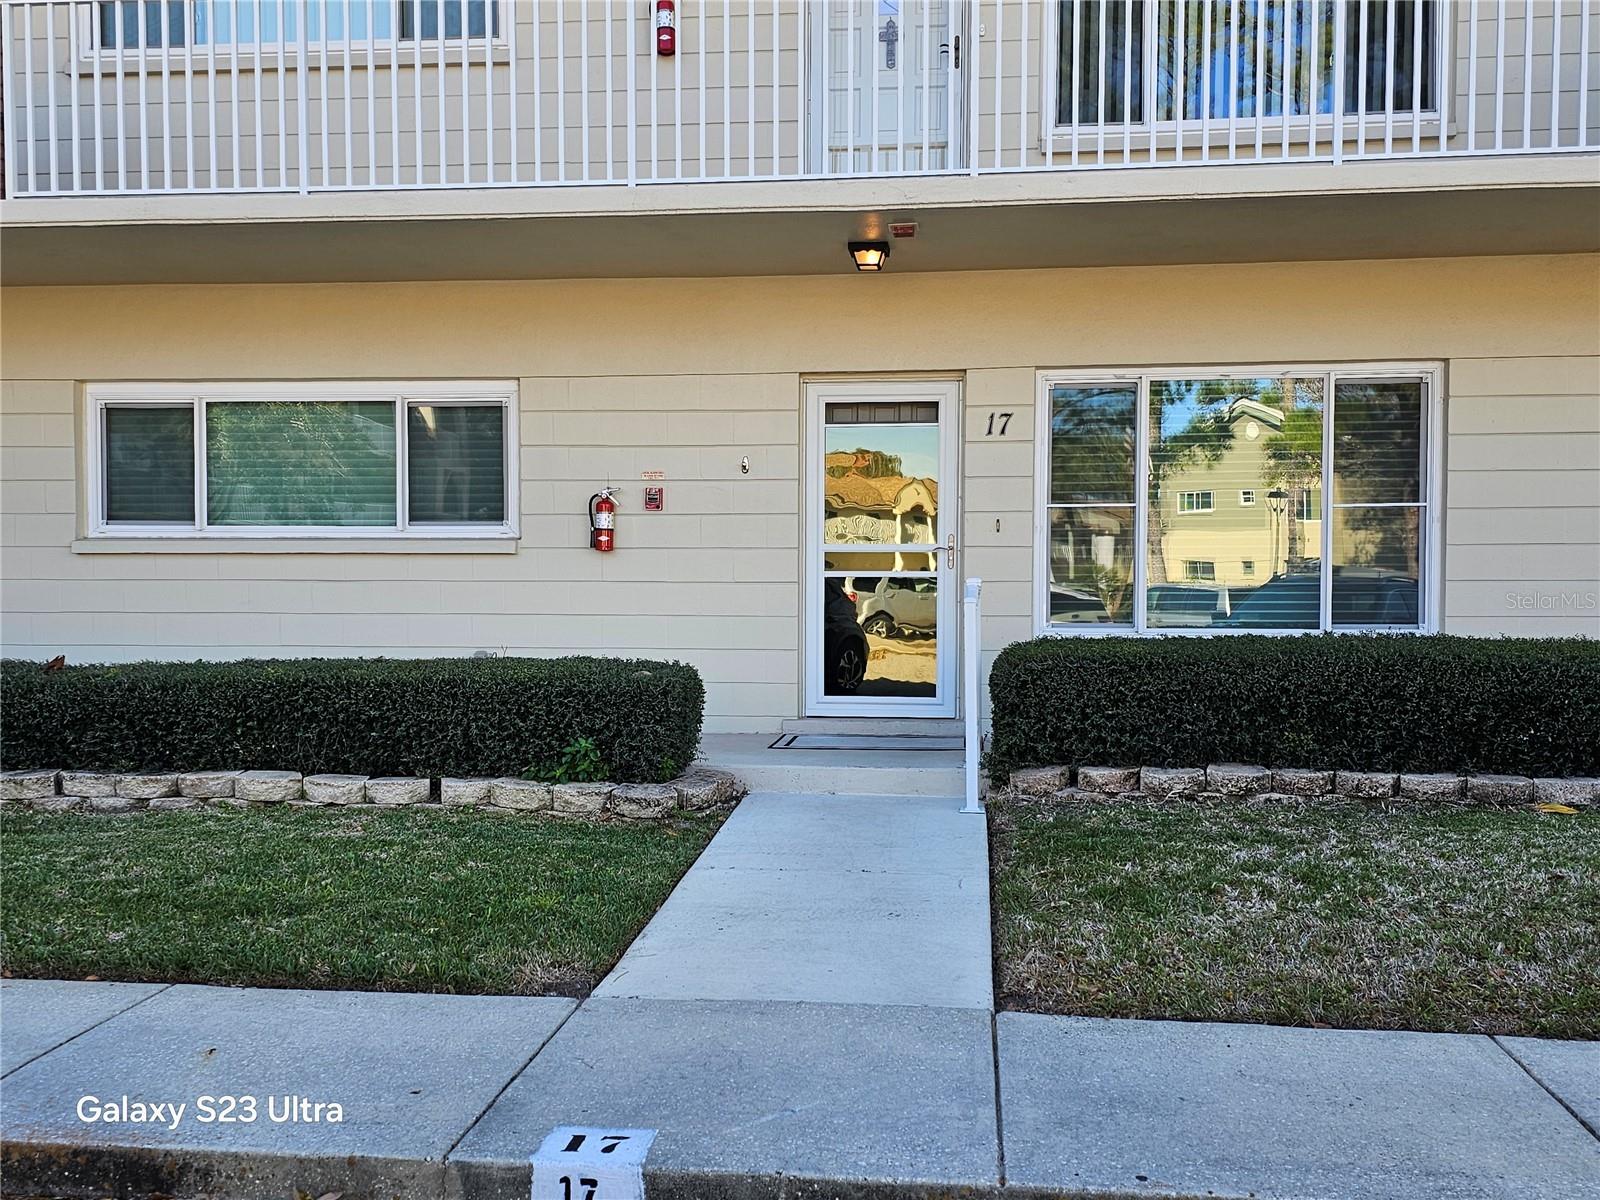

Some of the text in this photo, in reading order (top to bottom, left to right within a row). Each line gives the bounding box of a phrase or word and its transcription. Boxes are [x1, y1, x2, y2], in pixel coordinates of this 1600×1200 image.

[985, 412, 1014, 436] 17
[560, 1134, 631, 1153] 17
[559, 1176, 598, 1200] 17
